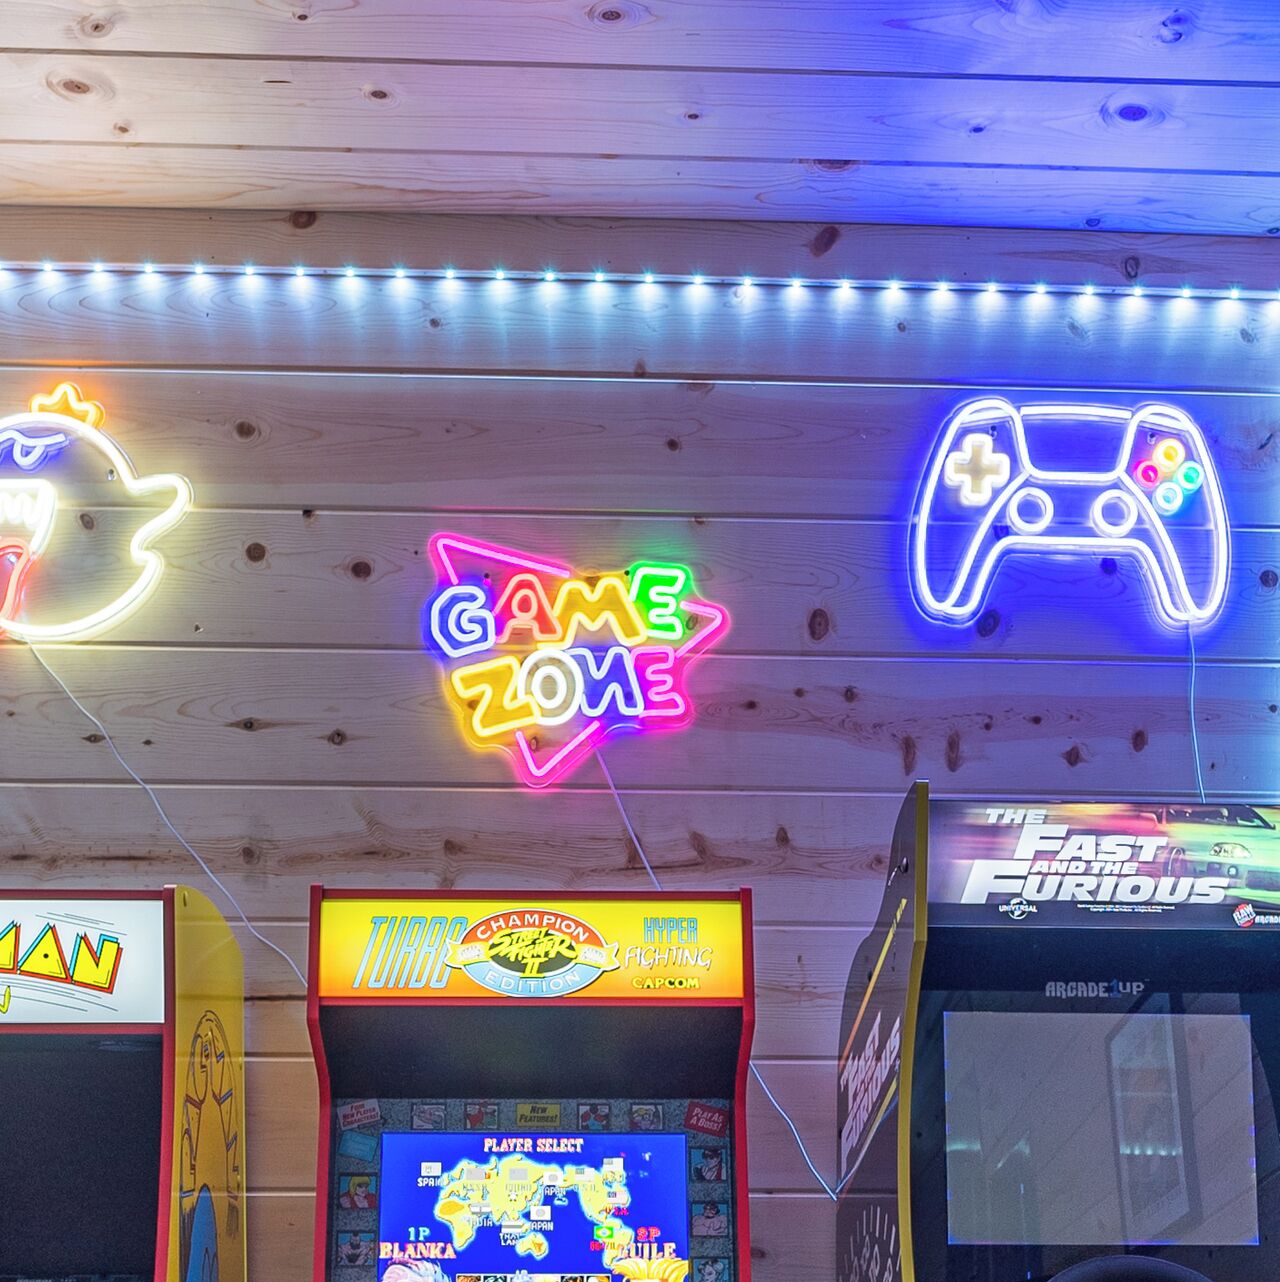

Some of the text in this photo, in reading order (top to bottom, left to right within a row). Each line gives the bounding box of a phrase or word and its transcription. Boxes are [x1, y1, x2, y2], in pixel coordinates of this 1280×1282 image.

[430, 567, 686, 659] GAME
[450, 645, 686, 737] ZONE
[984, 808, 1048, 825] THE
[1013, 824, 1169, 862] FAST
[1030, 860, 1139, 875] AND THE
[960, 859, 1230, 905] FURIOUS
[998, 904, 1038, 913] UNIVERSAL
[476, 913, 589, 941] CHAMPION
[644, 916, 698, 944] HYPER
[352, 915, 469, 990] TURBO
[624, 944, 713, 971] FIGHTING
[482, 970, 582, 993] EDITION
[632, 976, 700, 990] CAPCOM
[841, 1015, 901, 1179] FURIOUS
[484, 1137, 584, 1153] PLAYER SELECT
[408, 1226, 431, 1241] 1P
[636, 1226, 661, 1241] 2P
[378, 1241, 458, 1259] BLANKA
